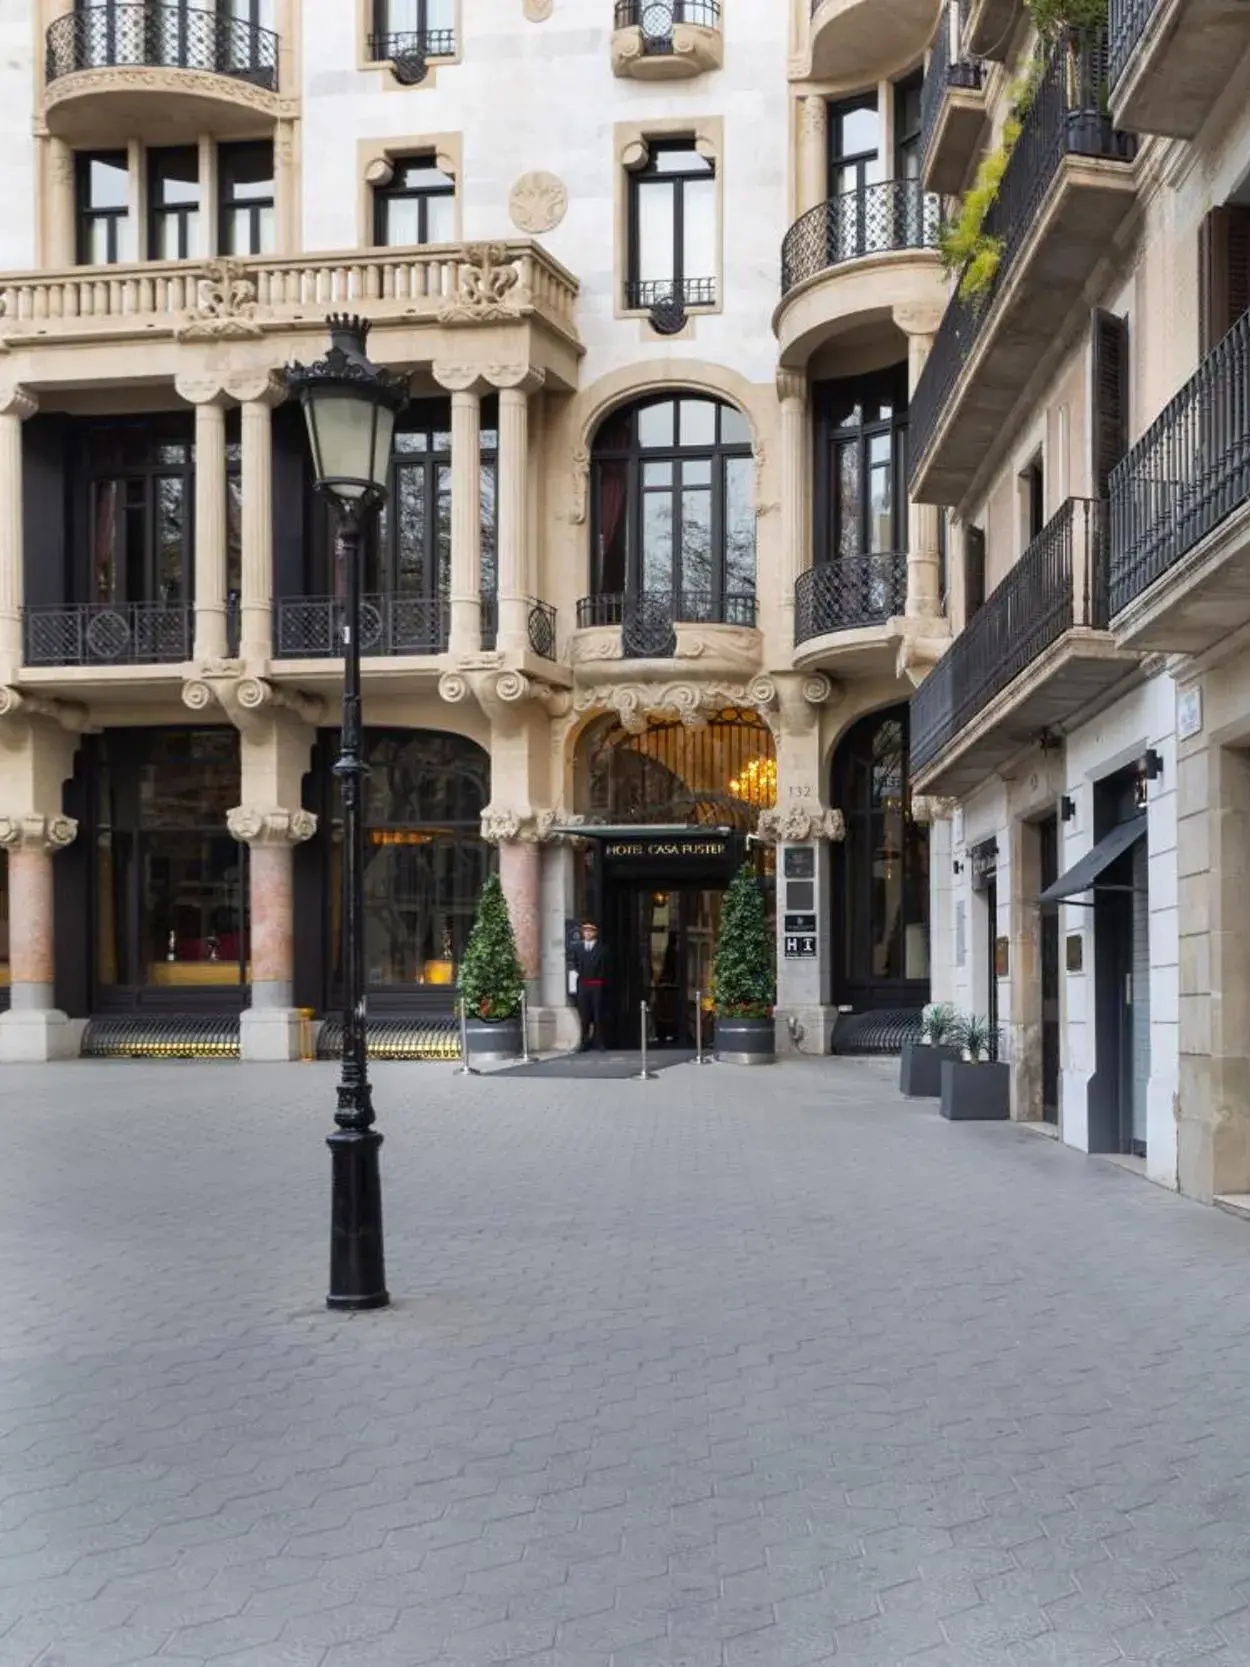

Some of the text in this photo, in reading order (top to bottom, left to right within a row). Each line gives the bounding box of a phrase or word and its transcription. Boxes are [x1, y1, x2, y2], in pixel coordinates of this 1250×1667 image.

[605, 843, 726, 855] HOTEL CASA FUSTER
